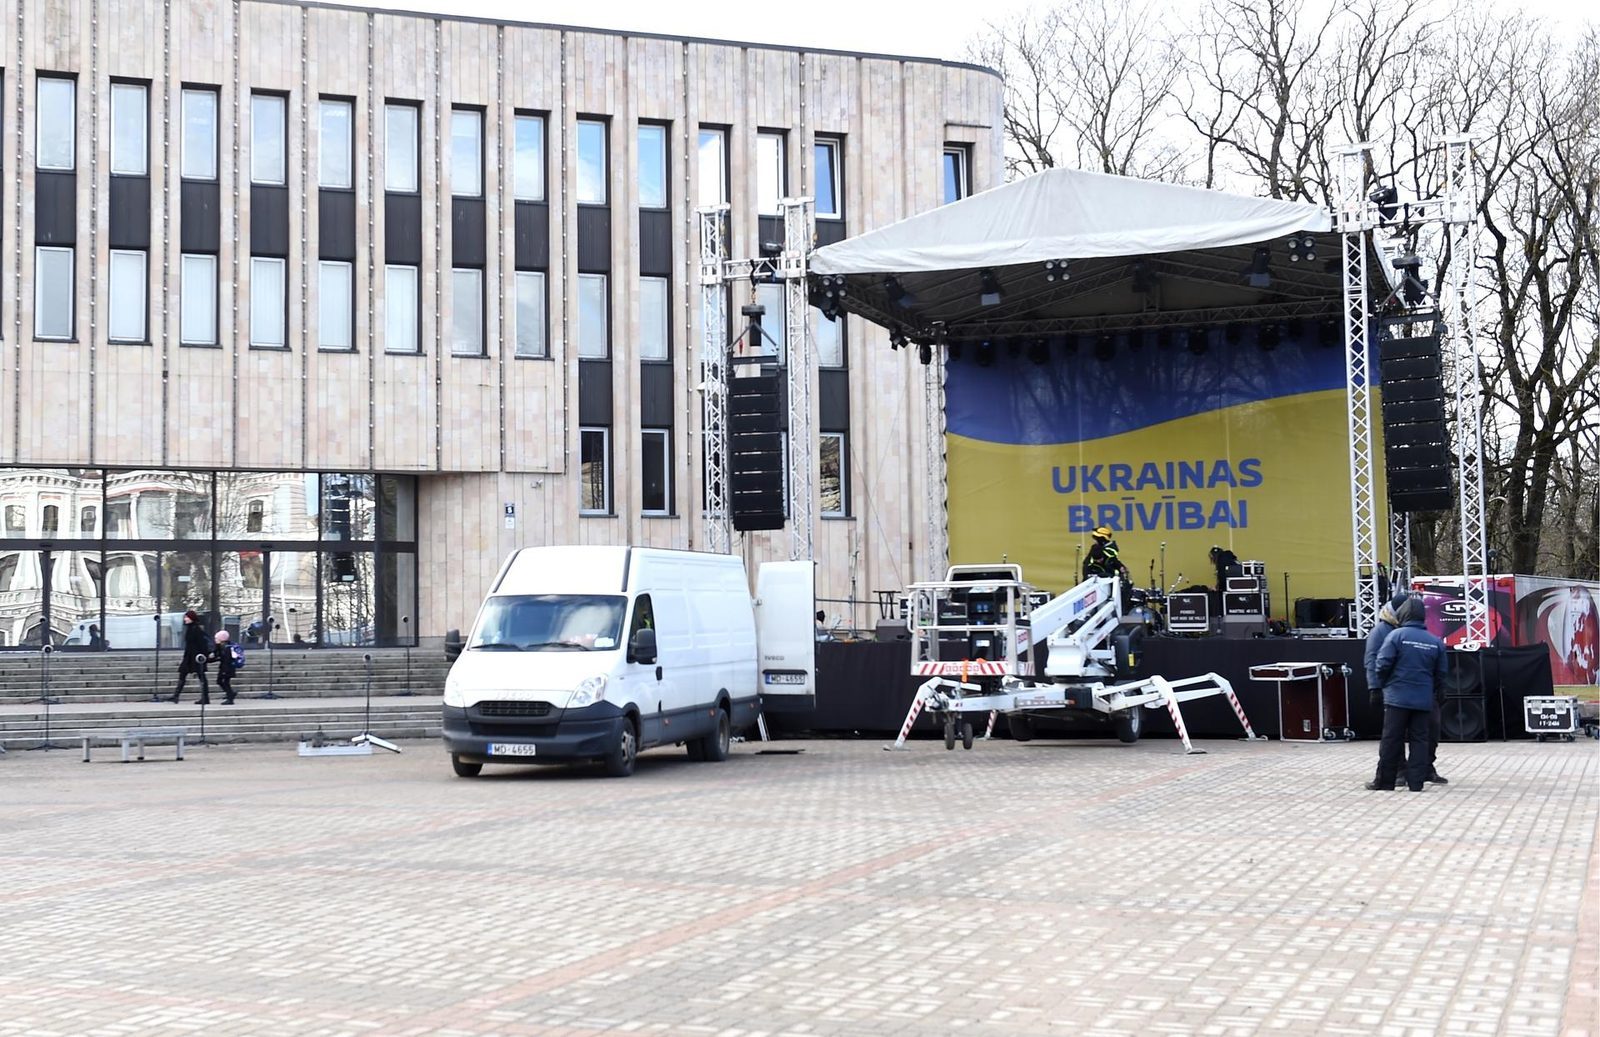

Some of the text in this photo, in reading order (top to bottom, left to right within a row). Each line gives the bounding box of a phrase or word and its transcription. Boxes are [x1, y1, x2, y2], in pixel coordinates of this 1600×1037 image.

[1052, 458, 1263, 494] UKRAINAS
[1068, 495, 1248, 533] BRĪVĪBAI
[494, 745, 534, 754] MD-4655
